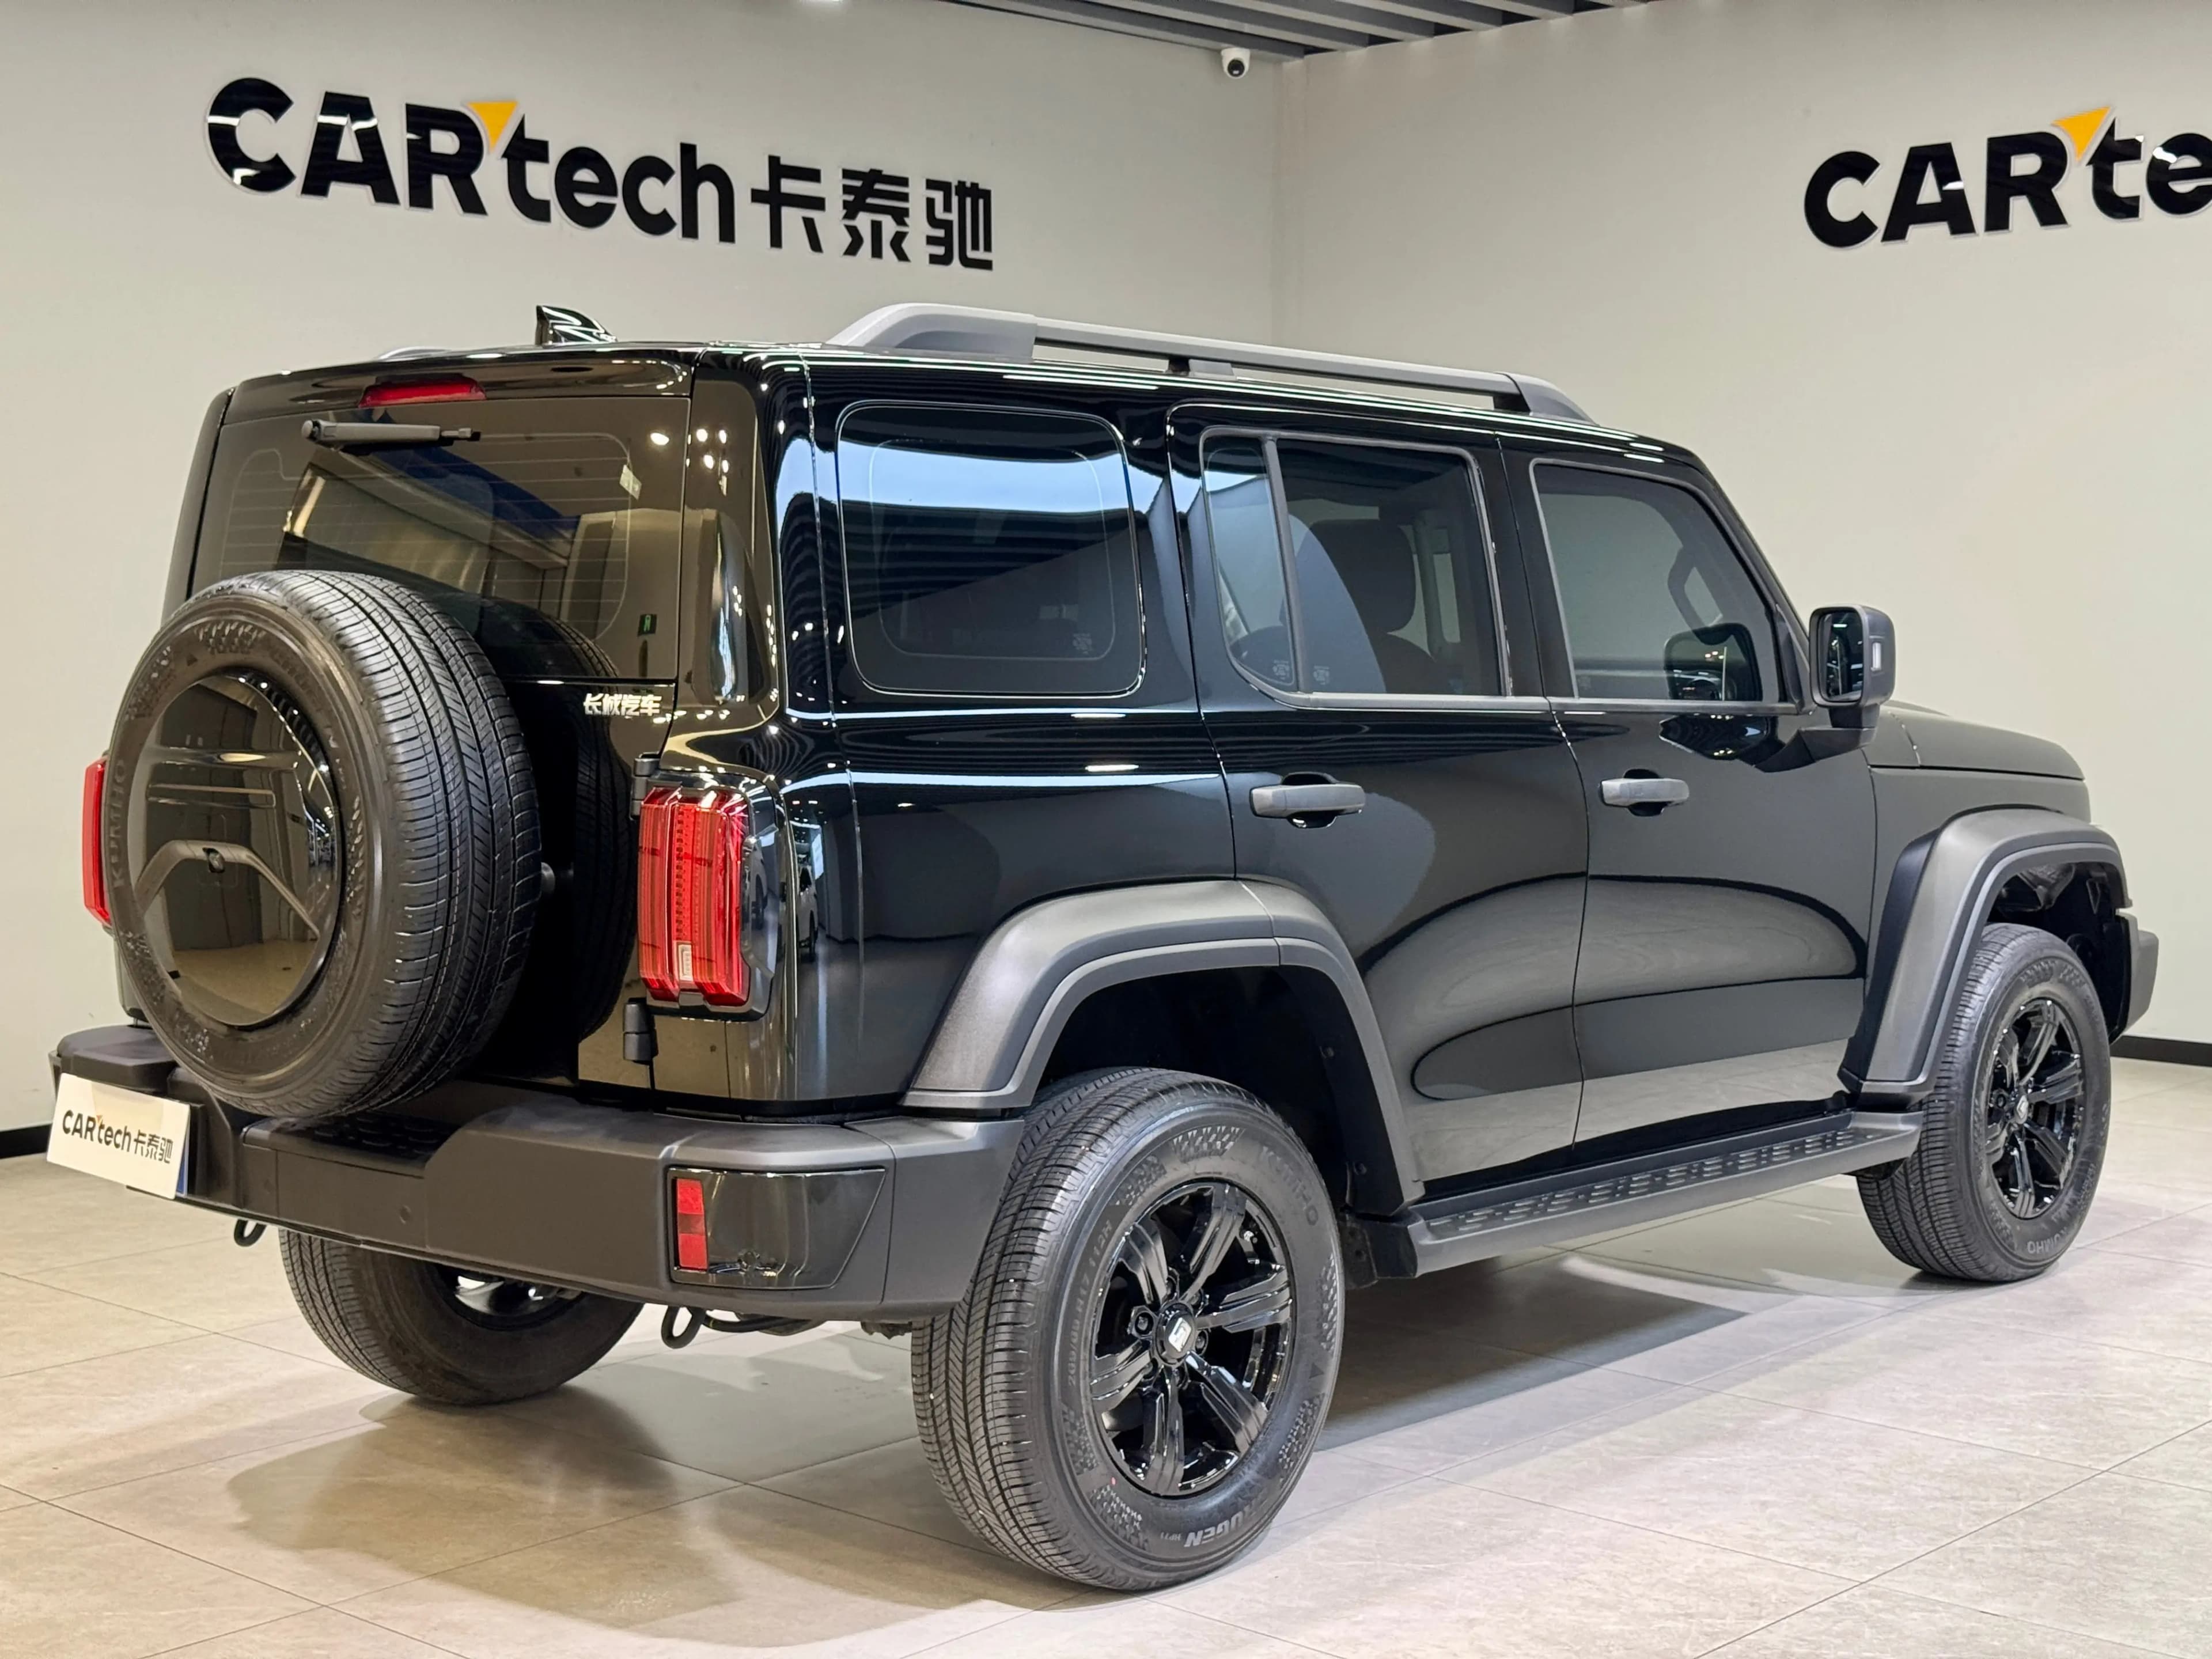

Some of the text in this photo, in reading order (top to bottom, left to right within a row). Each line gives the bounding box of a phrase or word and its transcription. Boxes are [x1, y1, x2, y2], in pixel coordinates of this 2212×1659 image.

[206, 77, 994, 271] CARtech 卡泰驰
[1803, 117, 2212, 249] CARte
[583, 693, 662, 716] 长城汽车
[62, 1109, 174, 1164] CARtech 卡泰驰
